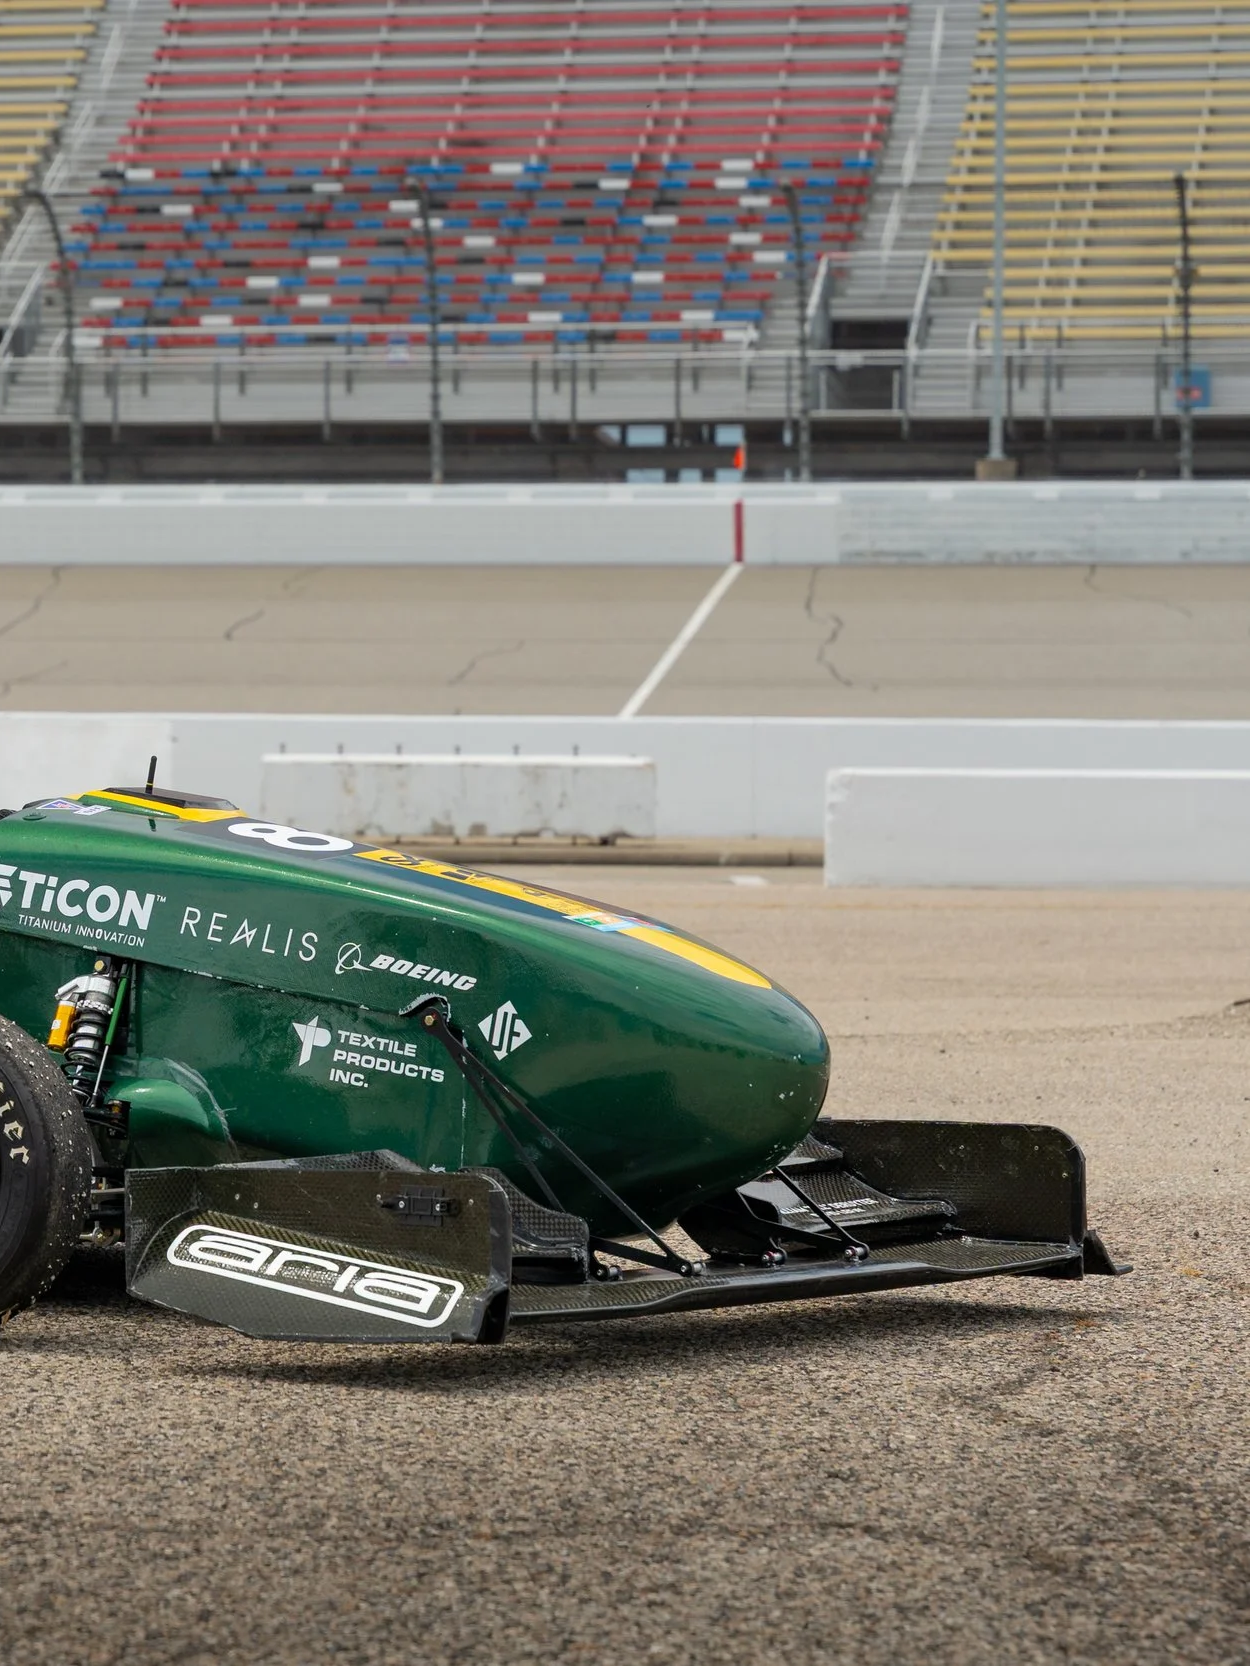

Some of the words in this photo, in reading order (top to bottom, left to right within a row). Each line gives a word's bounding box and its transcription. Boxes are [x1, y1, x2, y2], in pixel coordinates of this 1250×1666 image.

[18, 914, 71, 934] TITANIUM
[75, 927, 146, 948] INNOVATION
[180, 906, 318, 962] REALIS
[369, 953, 478, 991] BOEING
[337, 1029, 418, 1058] TEXTILE
[329, 1068, 369, 1088] INC.
[333, 1049, 446, 1083] PRODUCTS
[189, 1234, 440, 1314] aria
